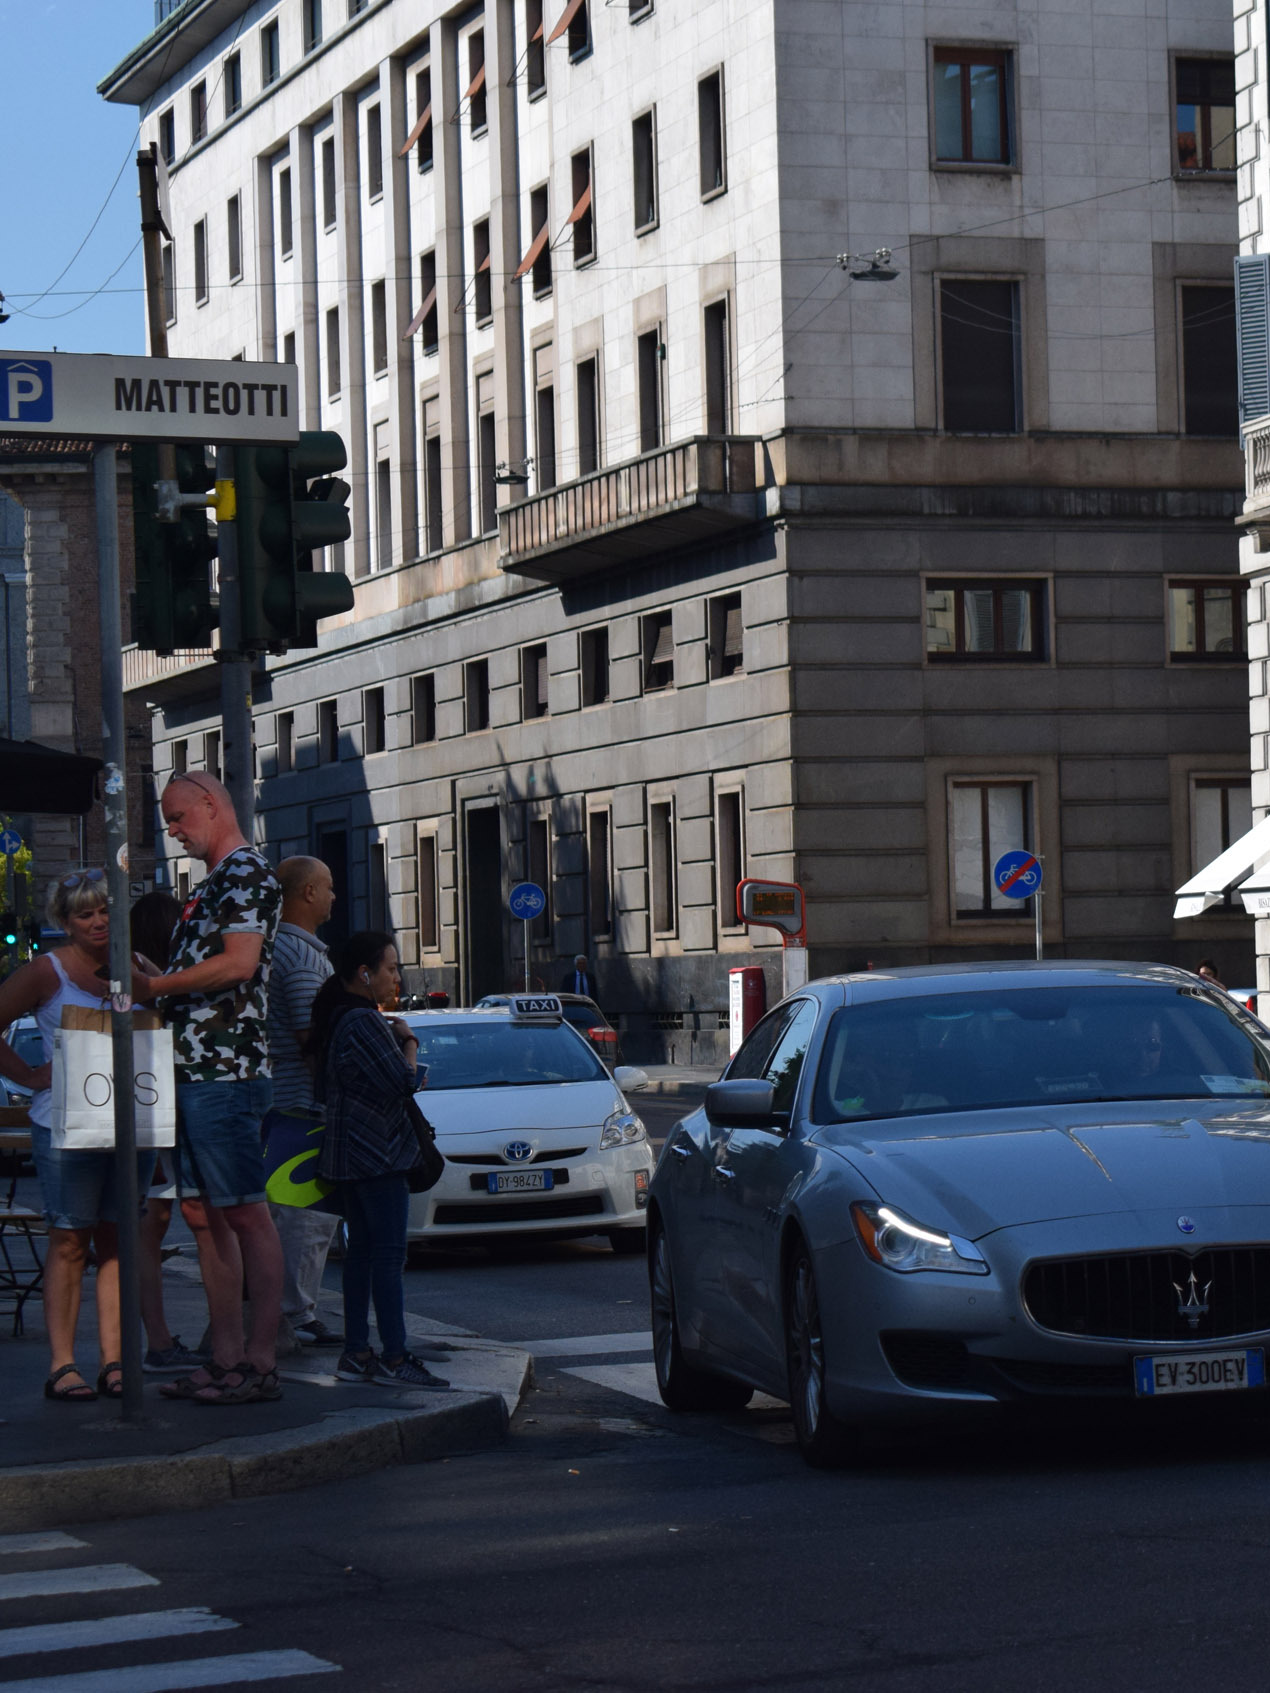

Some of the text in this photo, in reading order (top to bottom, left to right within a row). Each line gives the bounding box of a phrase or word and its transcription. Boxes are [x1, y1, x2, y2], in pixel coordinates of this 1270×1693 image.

[7, 373, 288, 419] P MATTEOTTI
[519, 1000, 555, 1012] TAXI
[84, 1072, 159, 1107] OS
